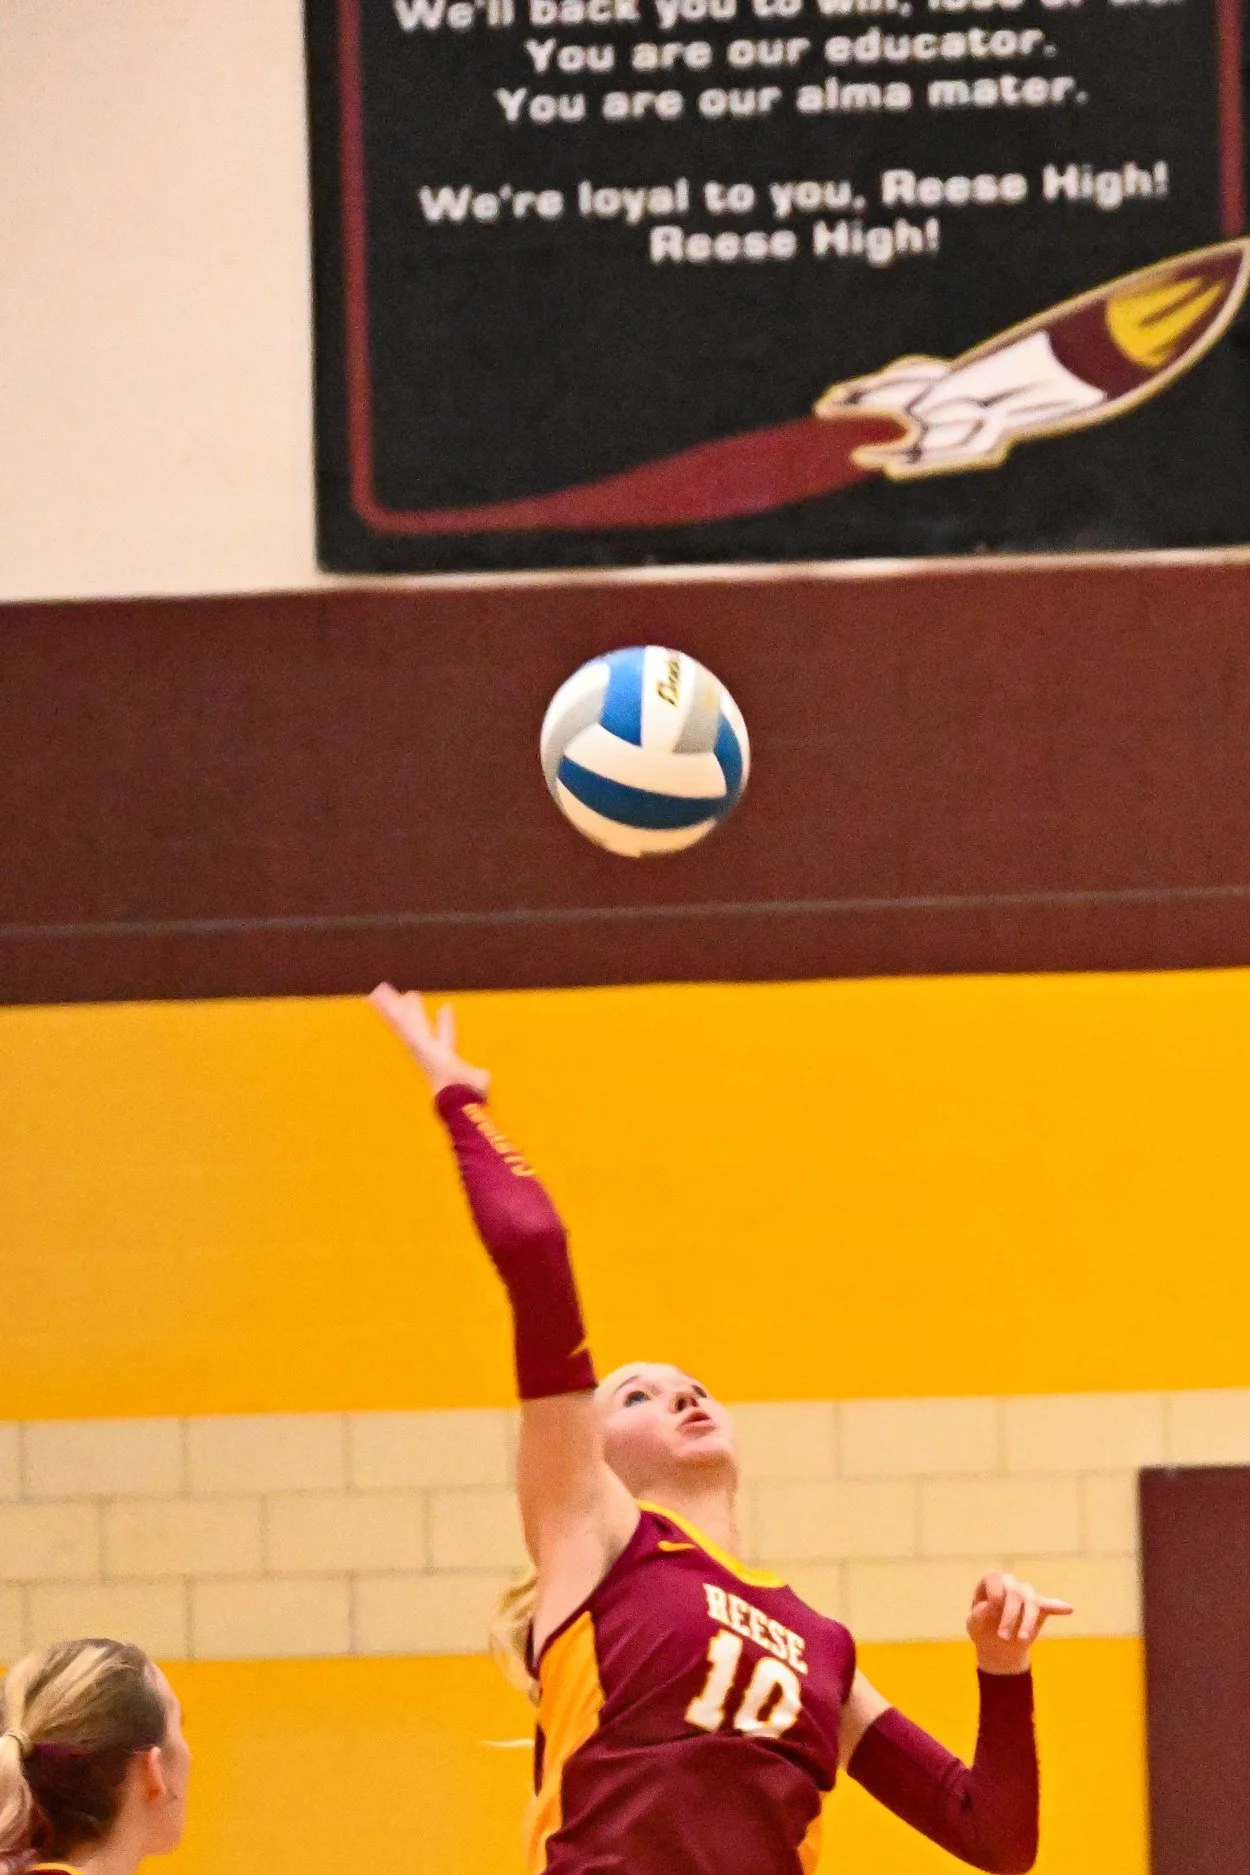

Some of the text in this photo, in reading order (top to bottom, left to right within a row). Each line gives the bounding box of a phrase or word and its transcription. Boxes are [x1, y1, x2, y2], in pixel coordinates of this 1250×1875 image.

[655, 0, 737, 29] you
[526, 28, 1057, 73] You are our educator.
[497, 75, 1088, 123] You are our alma mater.
[419, 161, 1168, 225] We're loyal to you, Reese High!
[650, 217, 939, 266] Reese High!
[703, 1583, 808, 1676] REESE
[684, 1628, 802, 1739] 10
